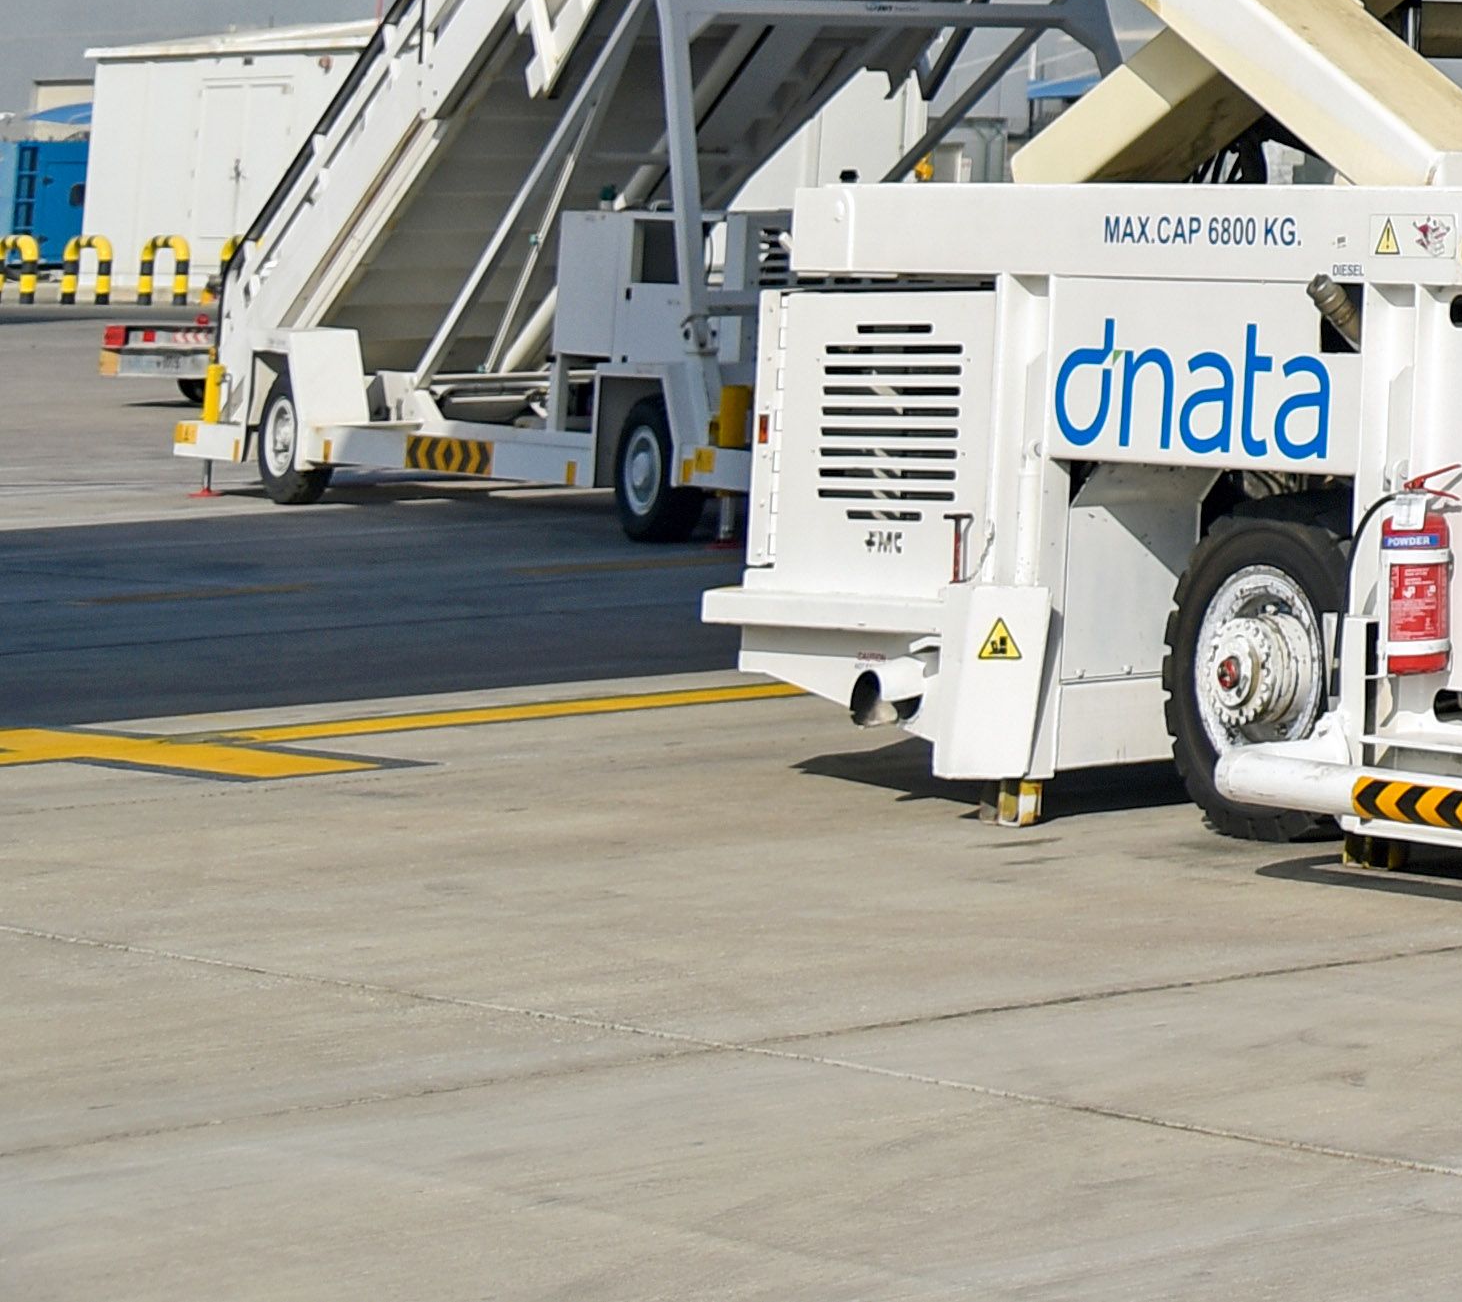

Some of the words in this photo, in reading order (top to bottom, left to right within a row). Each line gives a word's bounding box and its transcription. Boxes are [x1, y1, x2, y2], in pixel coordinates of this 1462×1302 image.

[1103, 215, 1201, 245] MAX.CAP
[1207, 216, 1257, 246] 6800
[1262, 216, 1302, 247] KG.
[1332, 263, 1365, 277] DIESEL
[1054, 318, 1332, 461] dnata
[1387, 535, 1431, 547] POWDER
